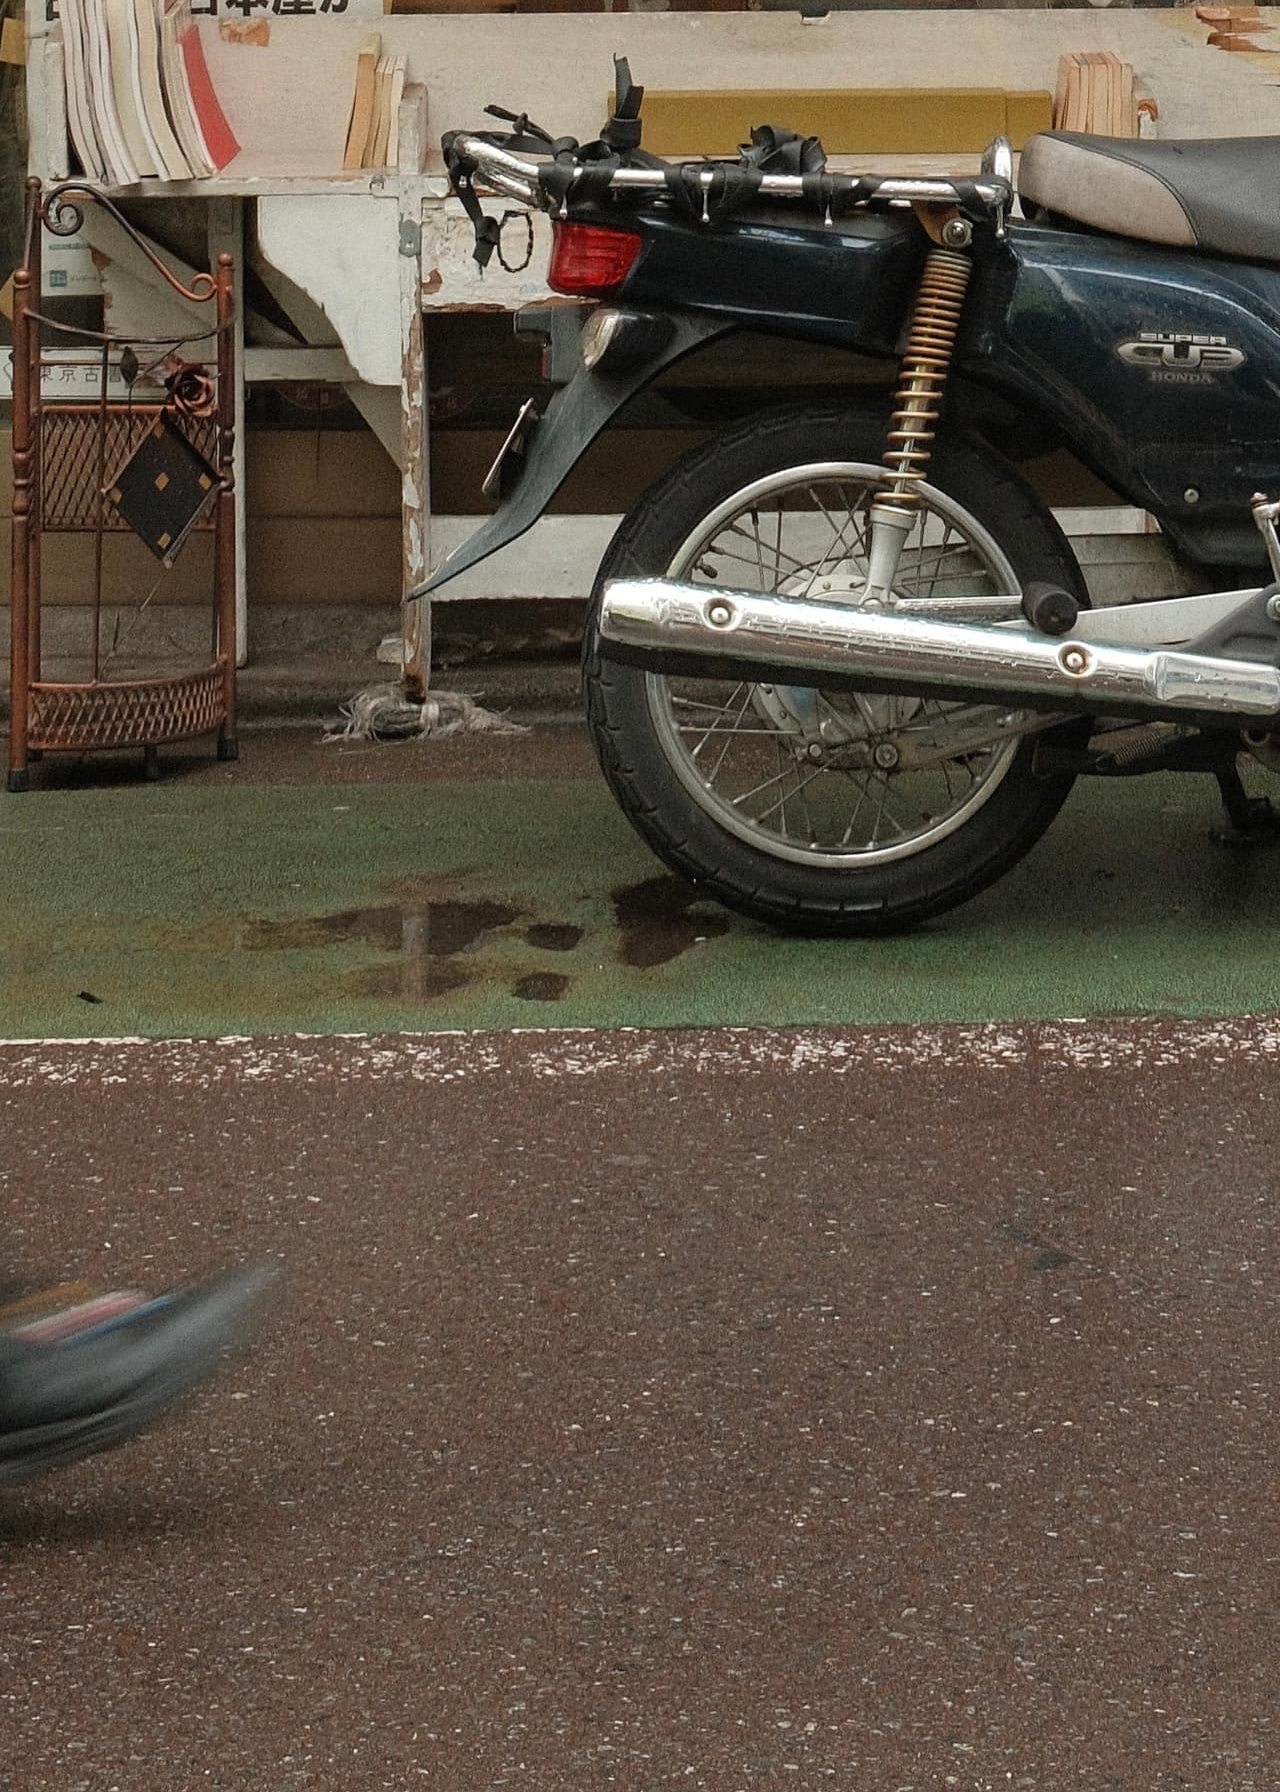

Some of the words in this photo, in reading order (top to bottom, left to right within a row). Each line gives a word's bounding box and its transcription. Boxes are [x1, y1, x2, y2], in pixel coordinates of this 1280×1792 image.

[1139, 332, 1228, 345] SUPER
[1117, 342, 1246, 368] CUB
[1151, 370, 1213, 384] HONDA
